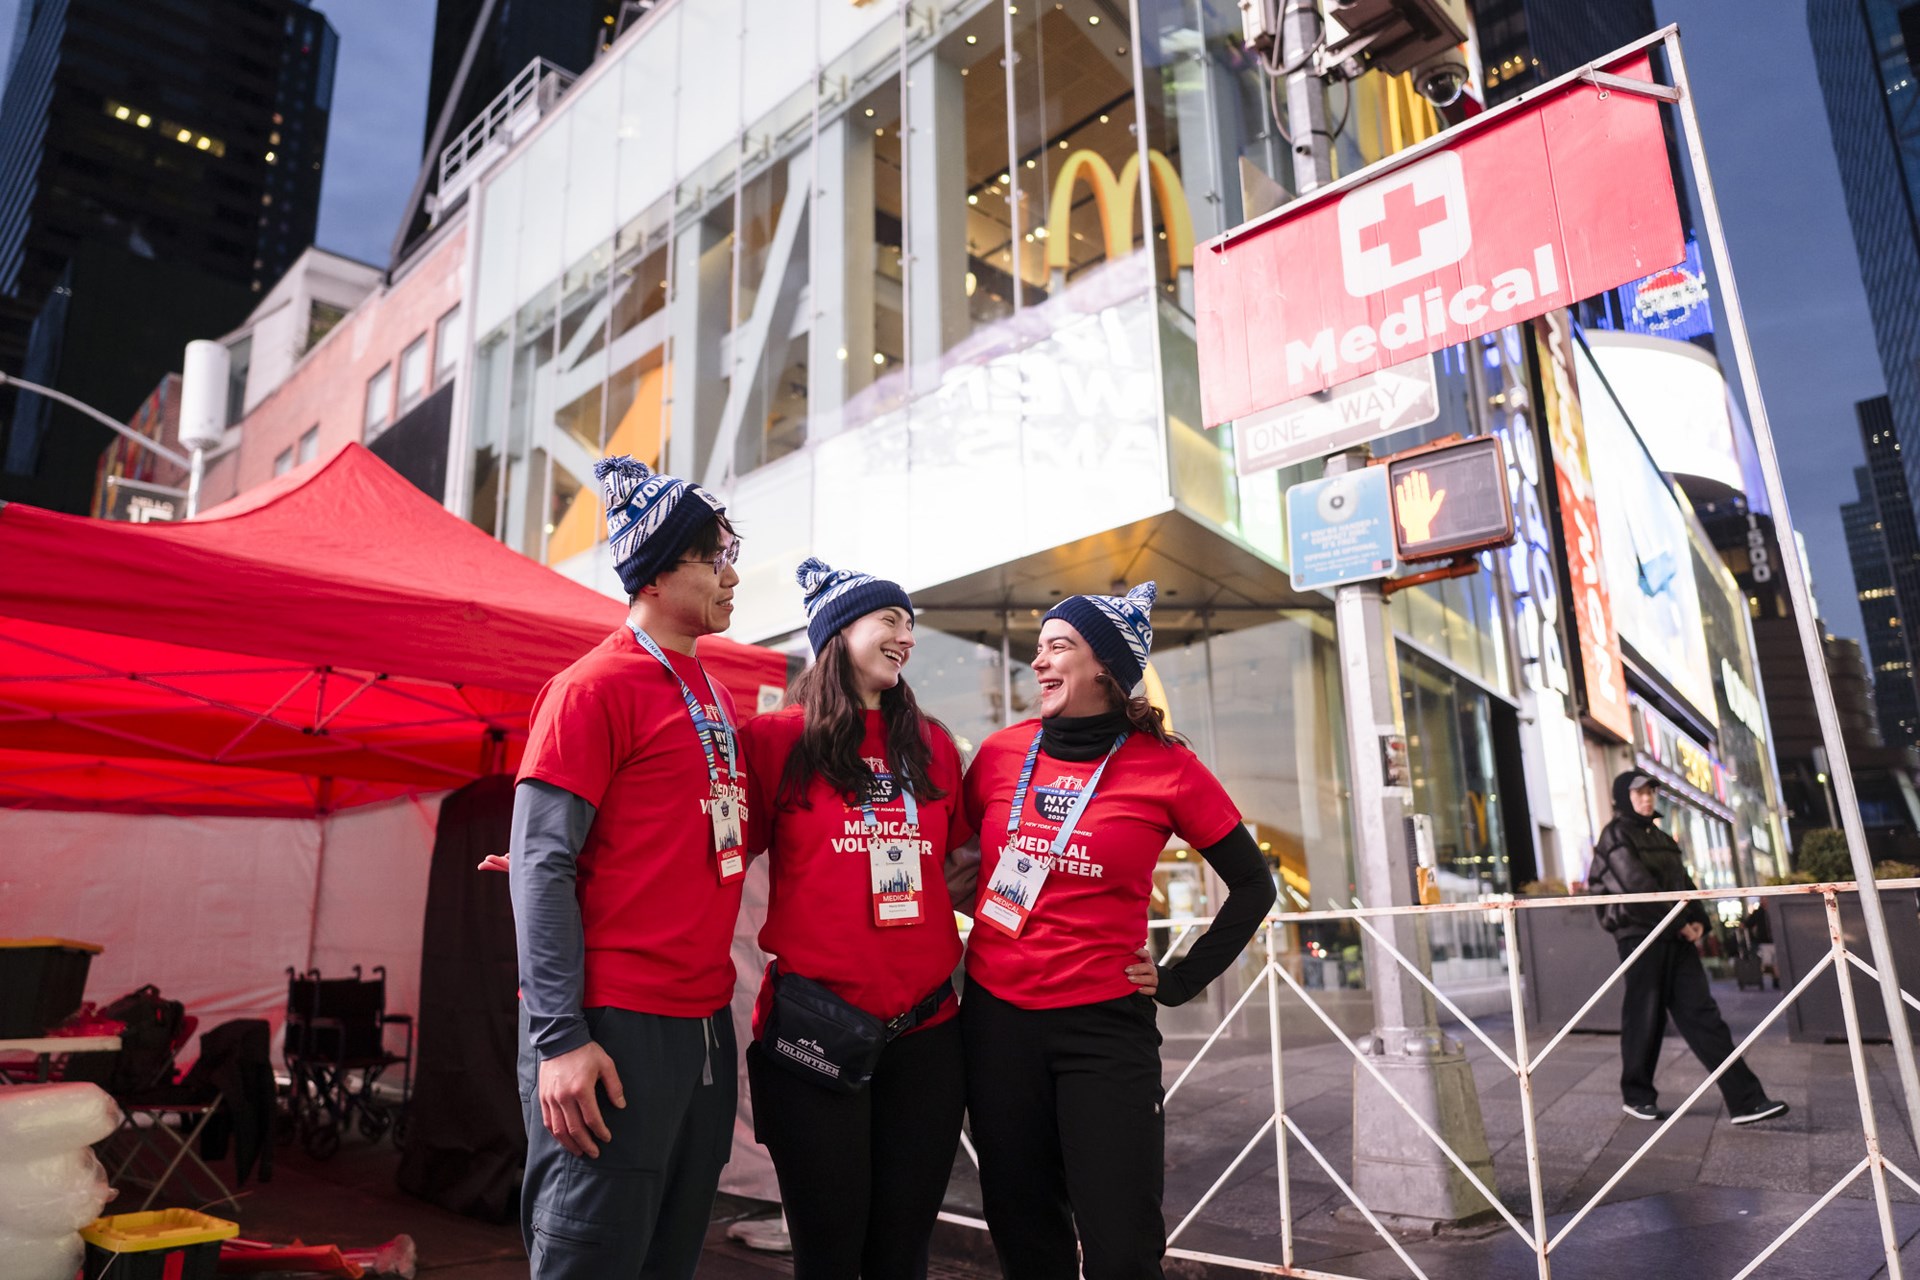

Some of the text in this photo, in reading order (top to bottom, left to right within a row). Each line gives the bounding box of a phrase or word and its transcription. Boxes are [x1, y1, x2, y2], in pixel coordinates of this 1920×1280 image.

[1285, 242, 1559, 385] Medical
[1252, 383, 1401, 451] ONE WAY
[714, 731, 727, 743] NY
[1044, 795, 1077, 807] NYC
[844, 820, 921, 837] MEDICAL
[1014, 834, 1090, 860] MEDAL
[992, 894, 1020, 914] MEDICAL
[776, 1039, 840, 1077] VOLUNTEER
